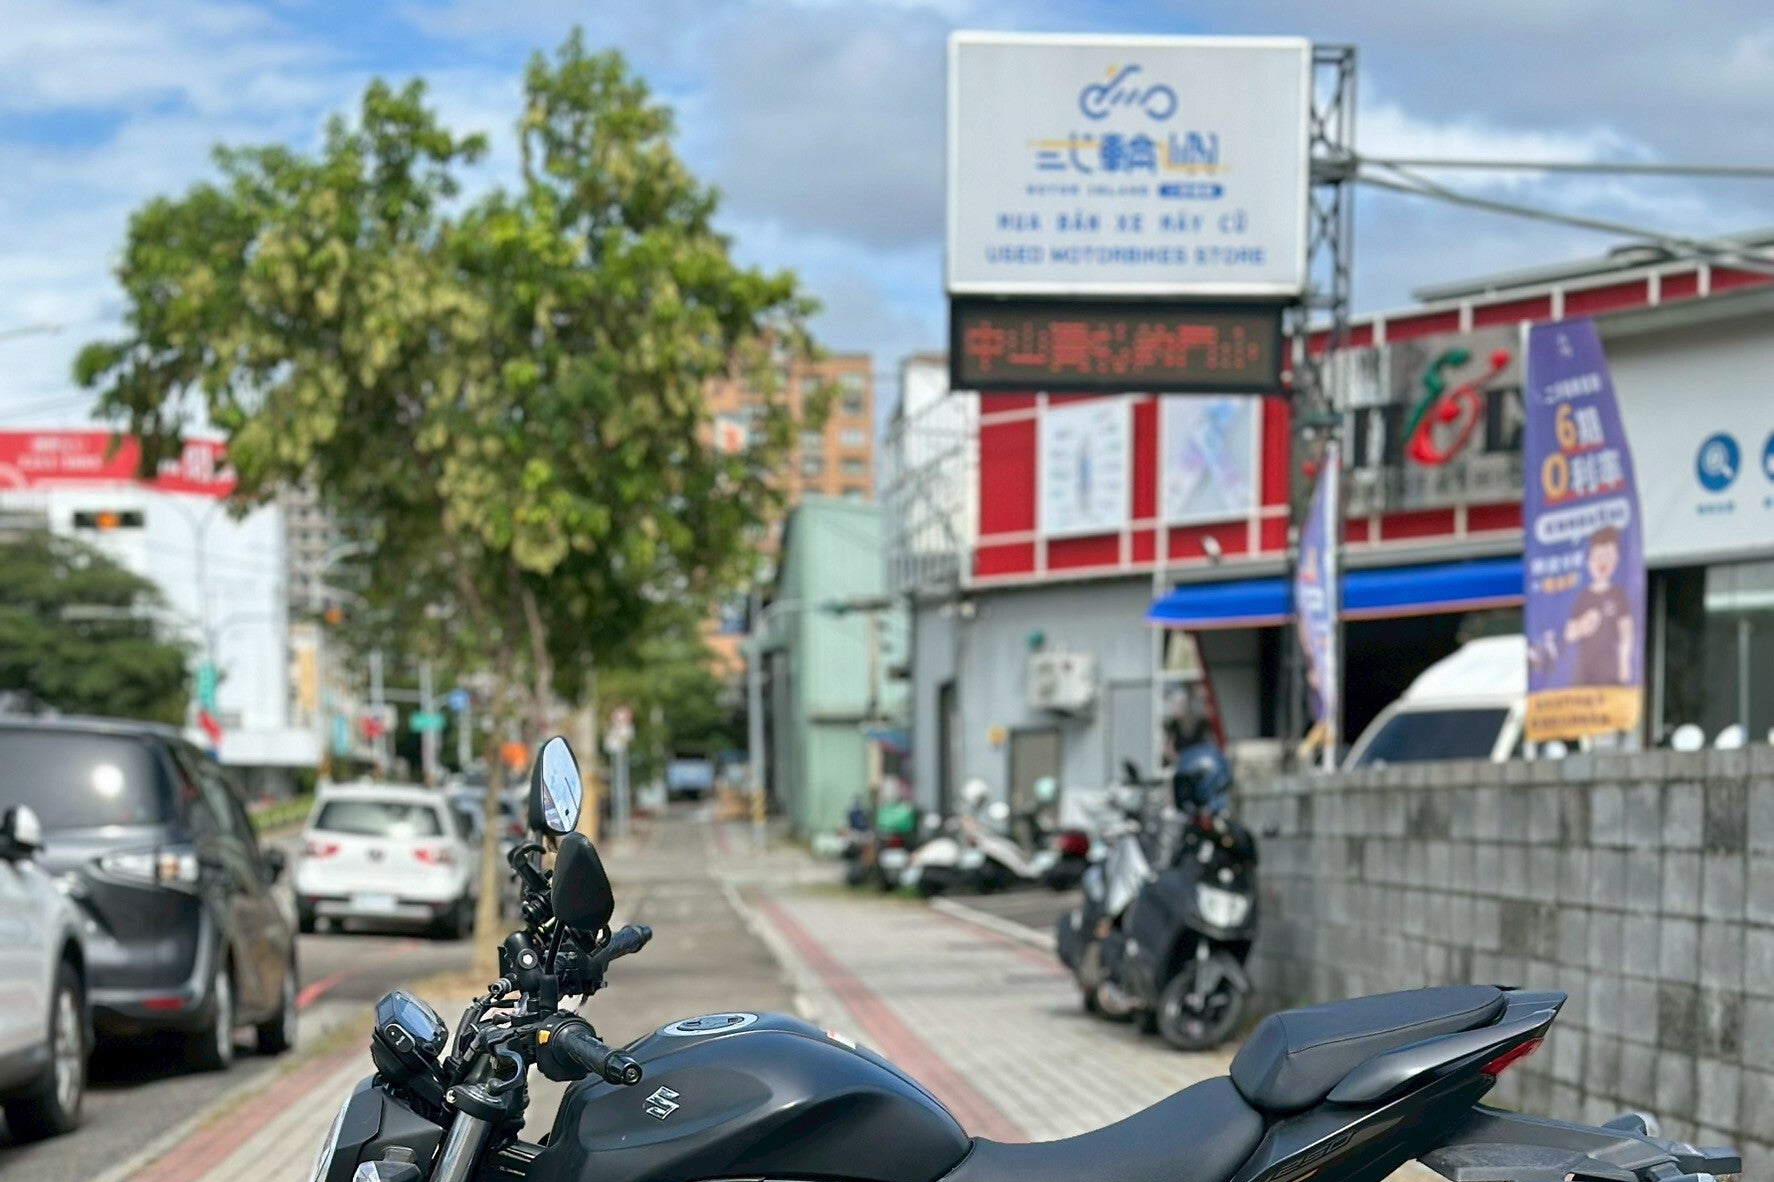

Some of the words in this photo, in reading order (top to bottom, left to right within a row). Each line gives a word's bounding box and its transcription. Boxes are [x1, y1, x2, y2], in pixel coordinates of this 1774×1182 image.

[996, 213, 1042, 233] MUA
[1115, 213, 1143, 233] XE
[985, 246, 1045, 265] USED
[1051, 245, 1188, 266] MOTORBIKES
[1195, 245, 1266, 266] STORE
